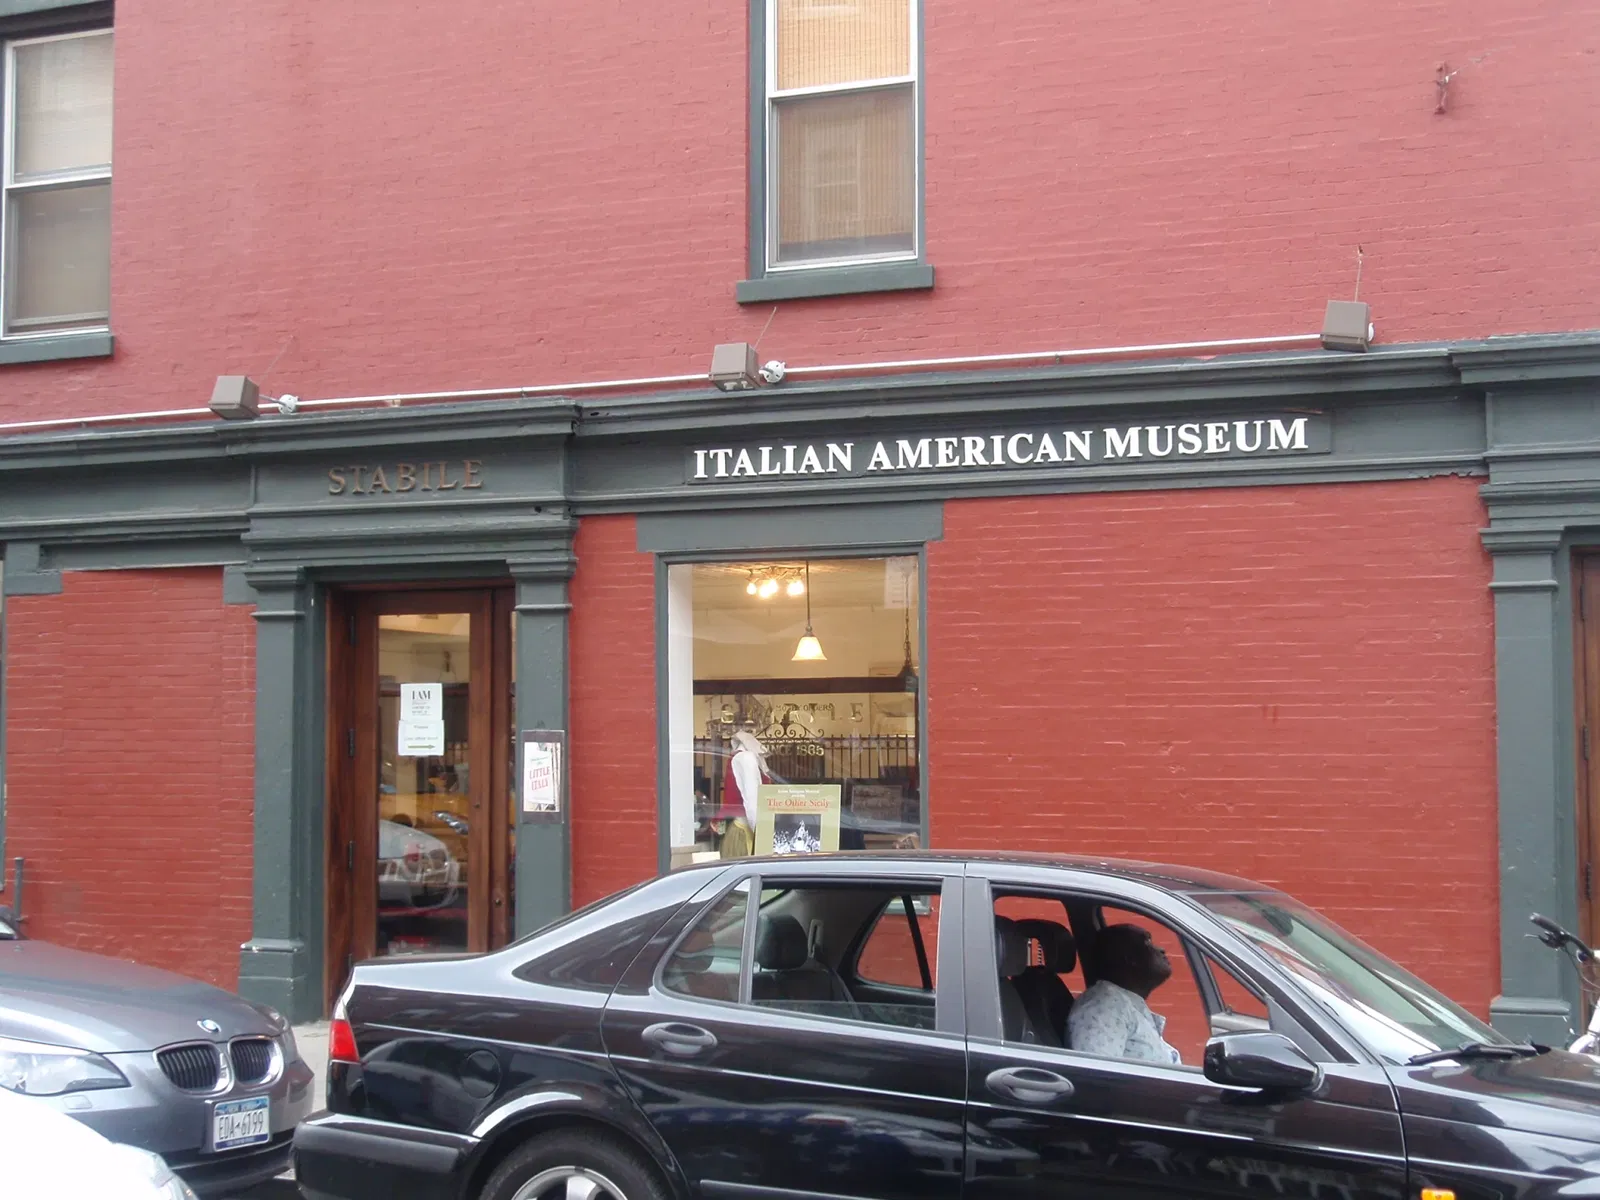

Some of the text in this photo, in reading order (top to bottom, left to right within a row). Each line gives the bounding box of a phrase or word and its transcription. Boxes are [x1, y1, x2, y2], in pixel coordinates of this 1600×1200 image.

[693, 418, 1309, 479] ITALIAN AMERICAN MUSEUM
[328, 459, 485, 496] STABILE
[528, 766, 550, 780] LITTLE
[767, 797, 829, 809] The Other Sicily
